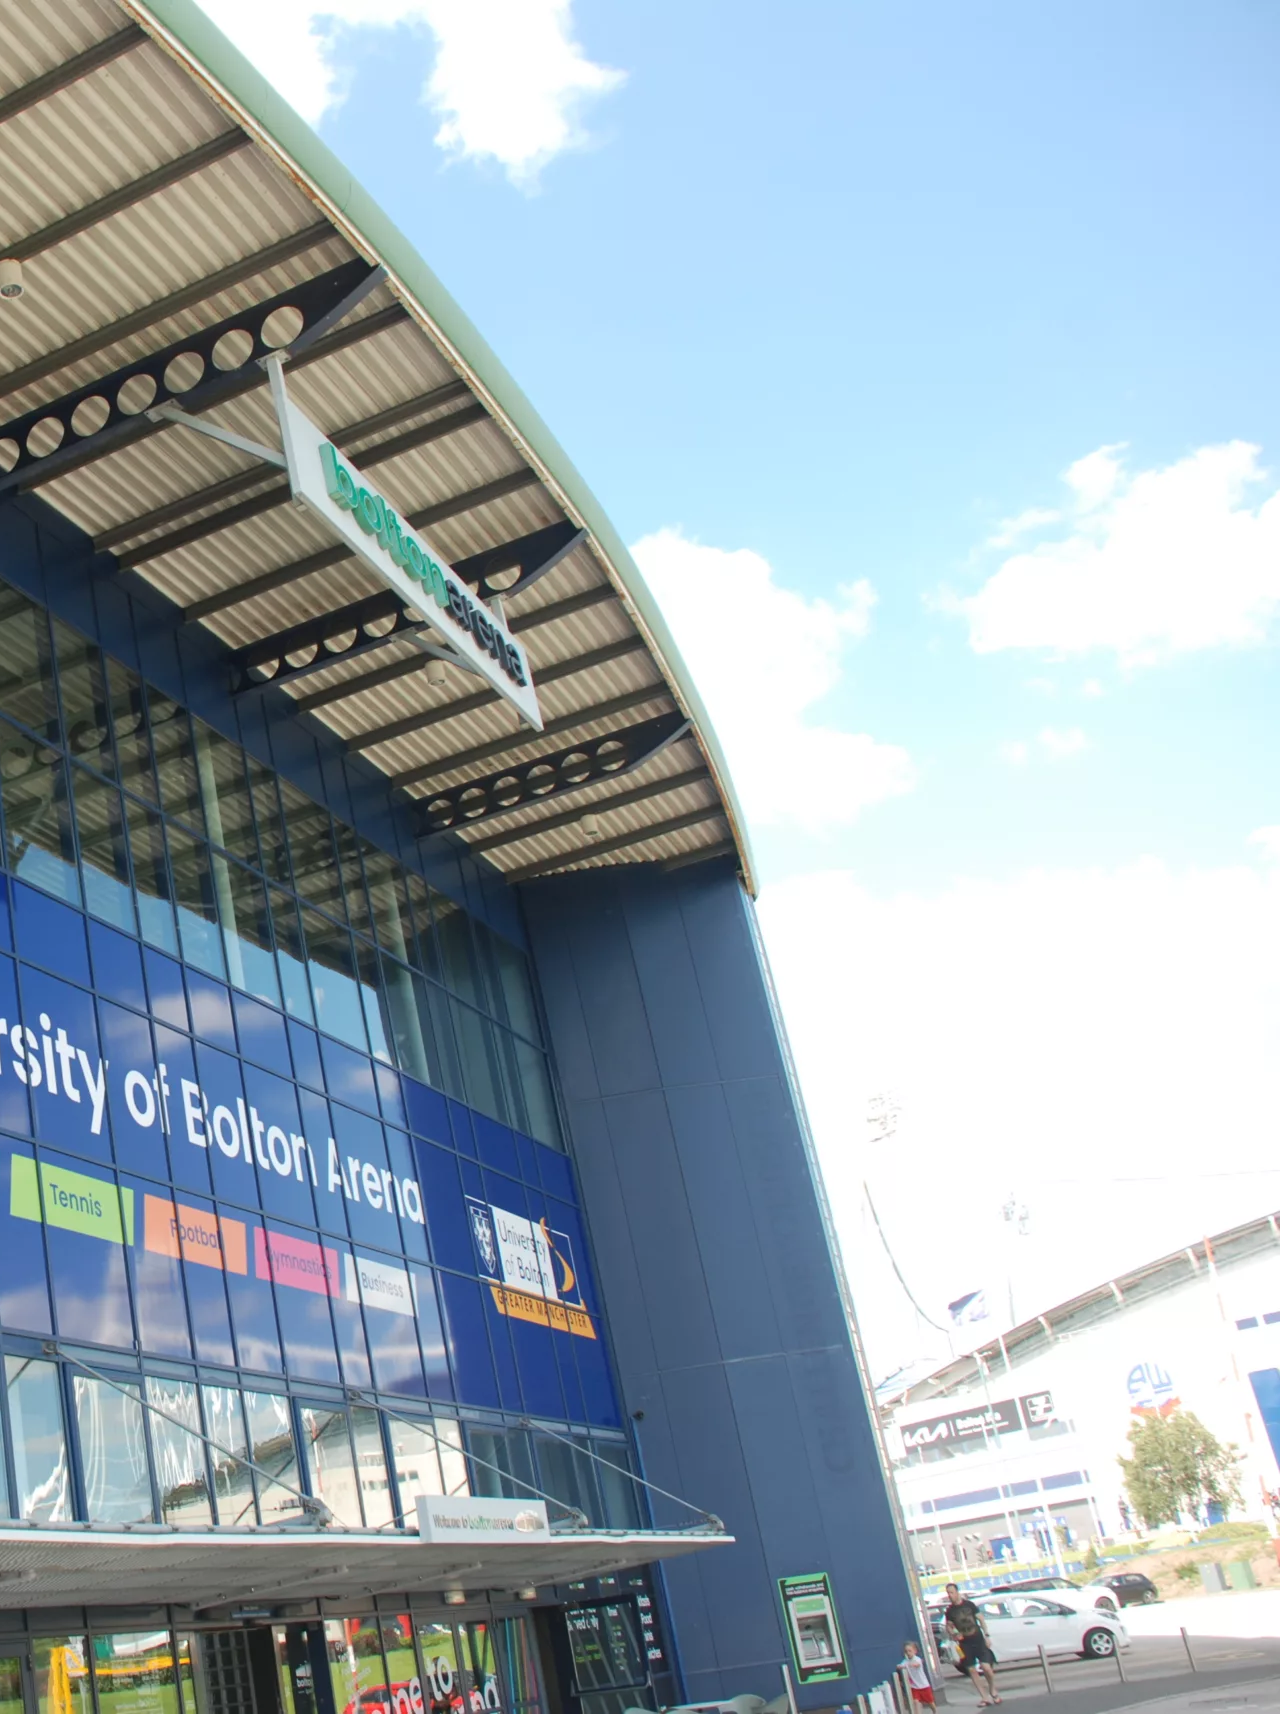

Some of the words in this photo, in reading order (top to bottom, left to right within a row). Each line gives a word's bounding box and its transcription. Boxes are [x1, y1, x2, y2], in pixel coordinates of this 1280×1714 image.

[124, 1062, 171, 1137] of
[180, 1077, 318, 1187] Bolton
[328, 1136, 426, 1225] Arena
[49, 1182, 103, 1218] Tennis
[169, 1217, 223, 1250] Footba
[496, 1218, 547, 1264] Universty
[265, 1244, 333, 1280] ymnastis
[505, 1253, 515, 1276] of
[361, 1271, 404, 1299] Business
[496, 1289, 535, 1314] GREATER
[535, 1301, 588, 1329] MANCHSTER
[426, 1655, 454, 1701] to
